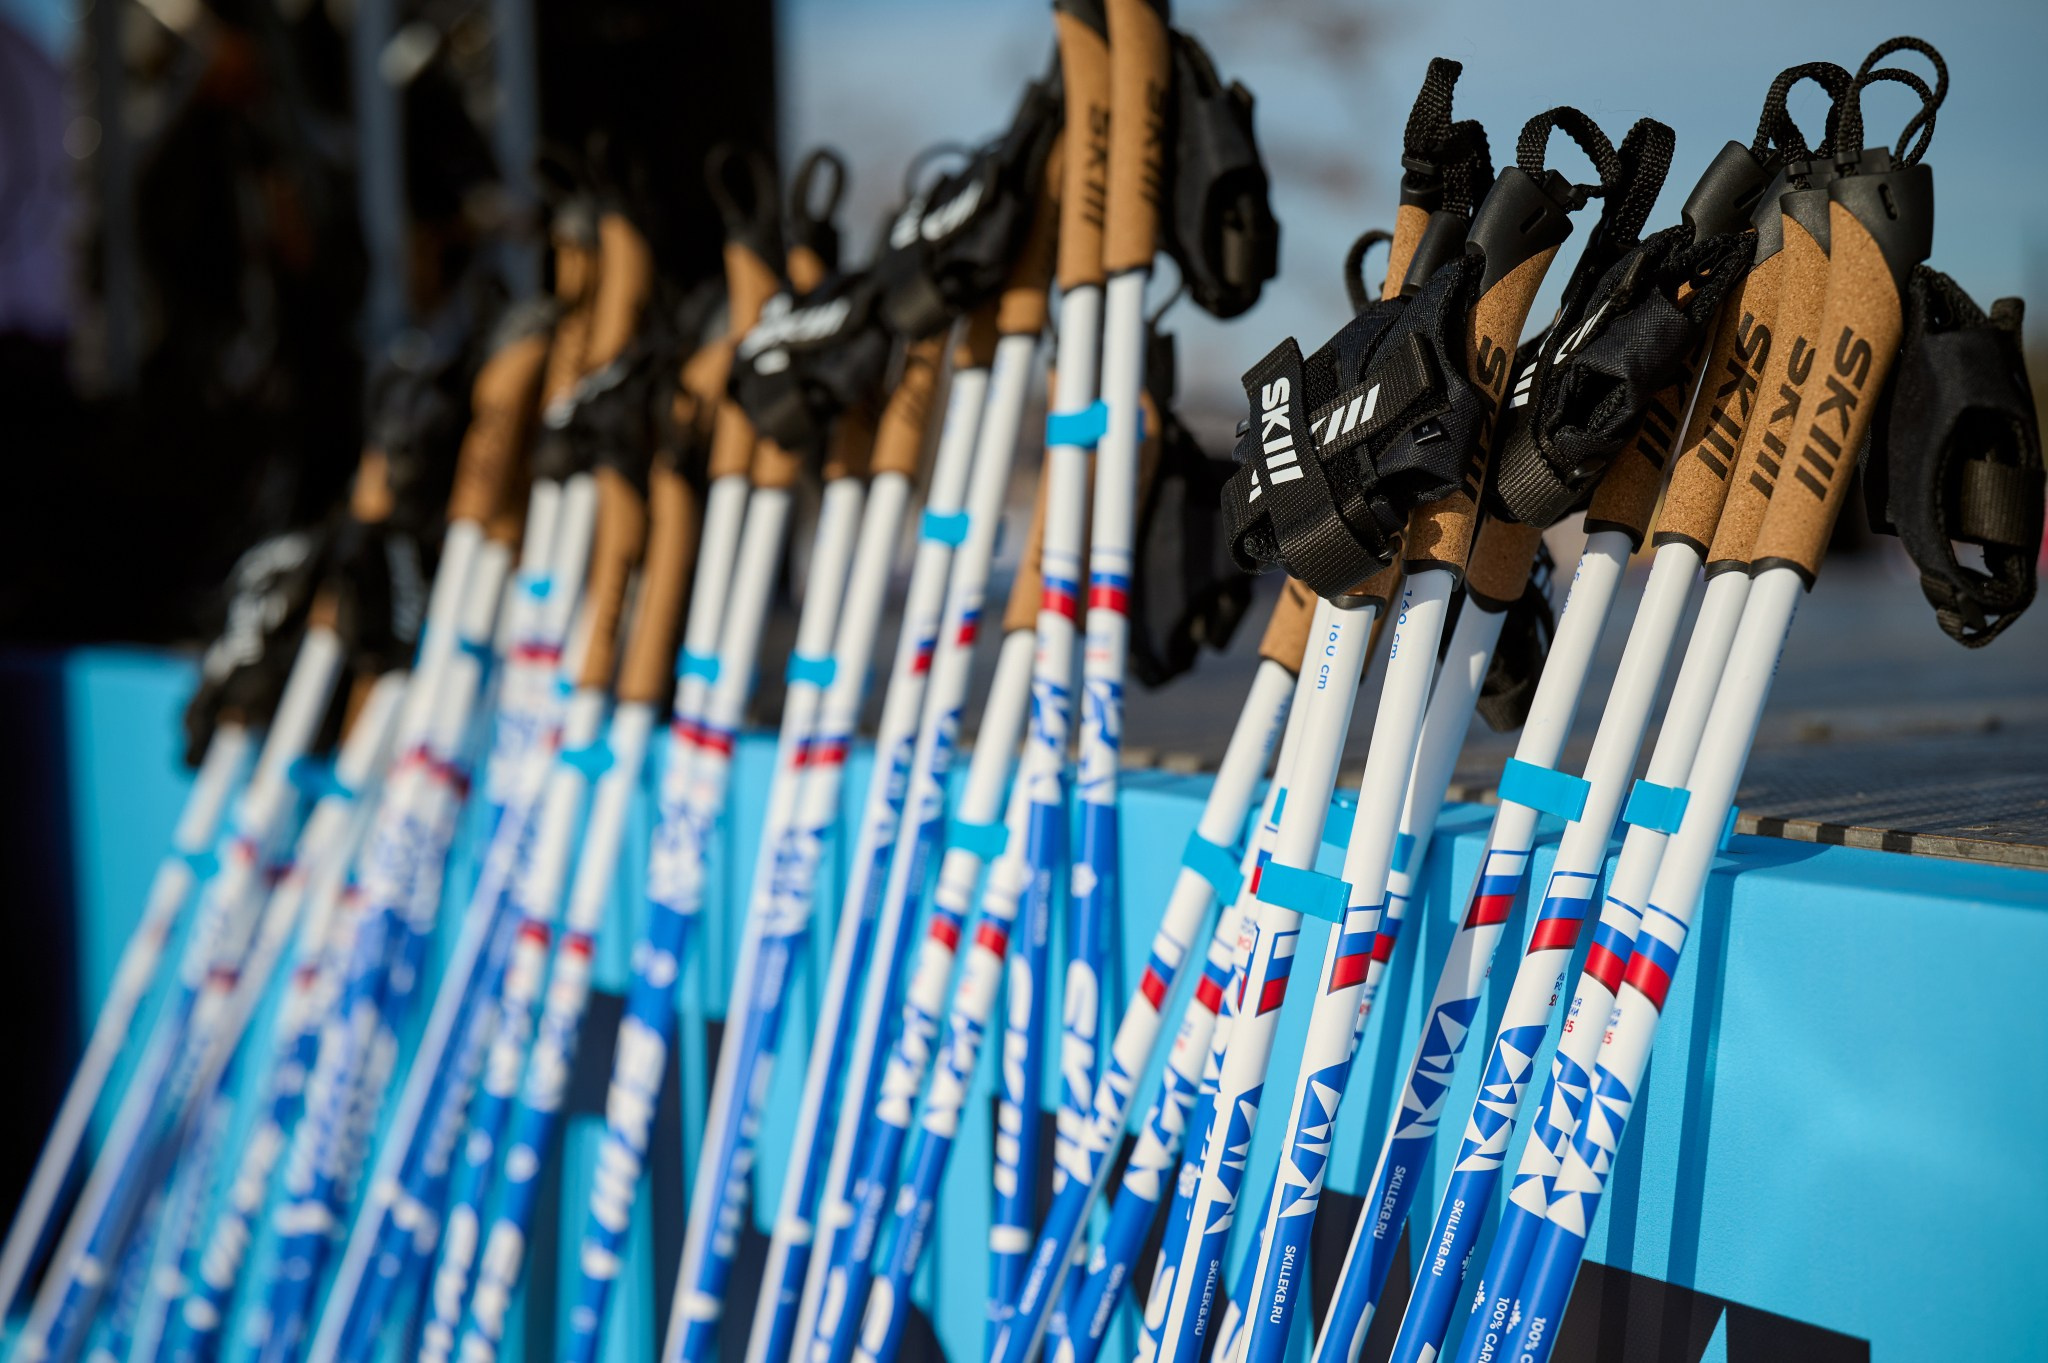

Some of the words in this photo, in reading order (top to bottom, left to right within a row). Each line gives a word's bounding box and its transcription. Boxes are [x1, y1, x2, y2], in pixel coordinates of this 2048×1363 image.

[1398, 590, 1413, 625] 160
[1390, 633, 1400, 660] cm
[1317, 664, 1330, 690] cm
[1373, 1165, 1407, 1240] SKILLEKB.RU
[1431, 1198, 1466, 1277] SKILLEKB.RU
[1194, 1259, 1219, 1337] SKILLEKB.RU
[1269, 1244, 1297, 1324] SKILLEKB.RU
[1489, 1297, 1510, 1330] 100%
[1524, 1317, 1547, 1351] 100%
